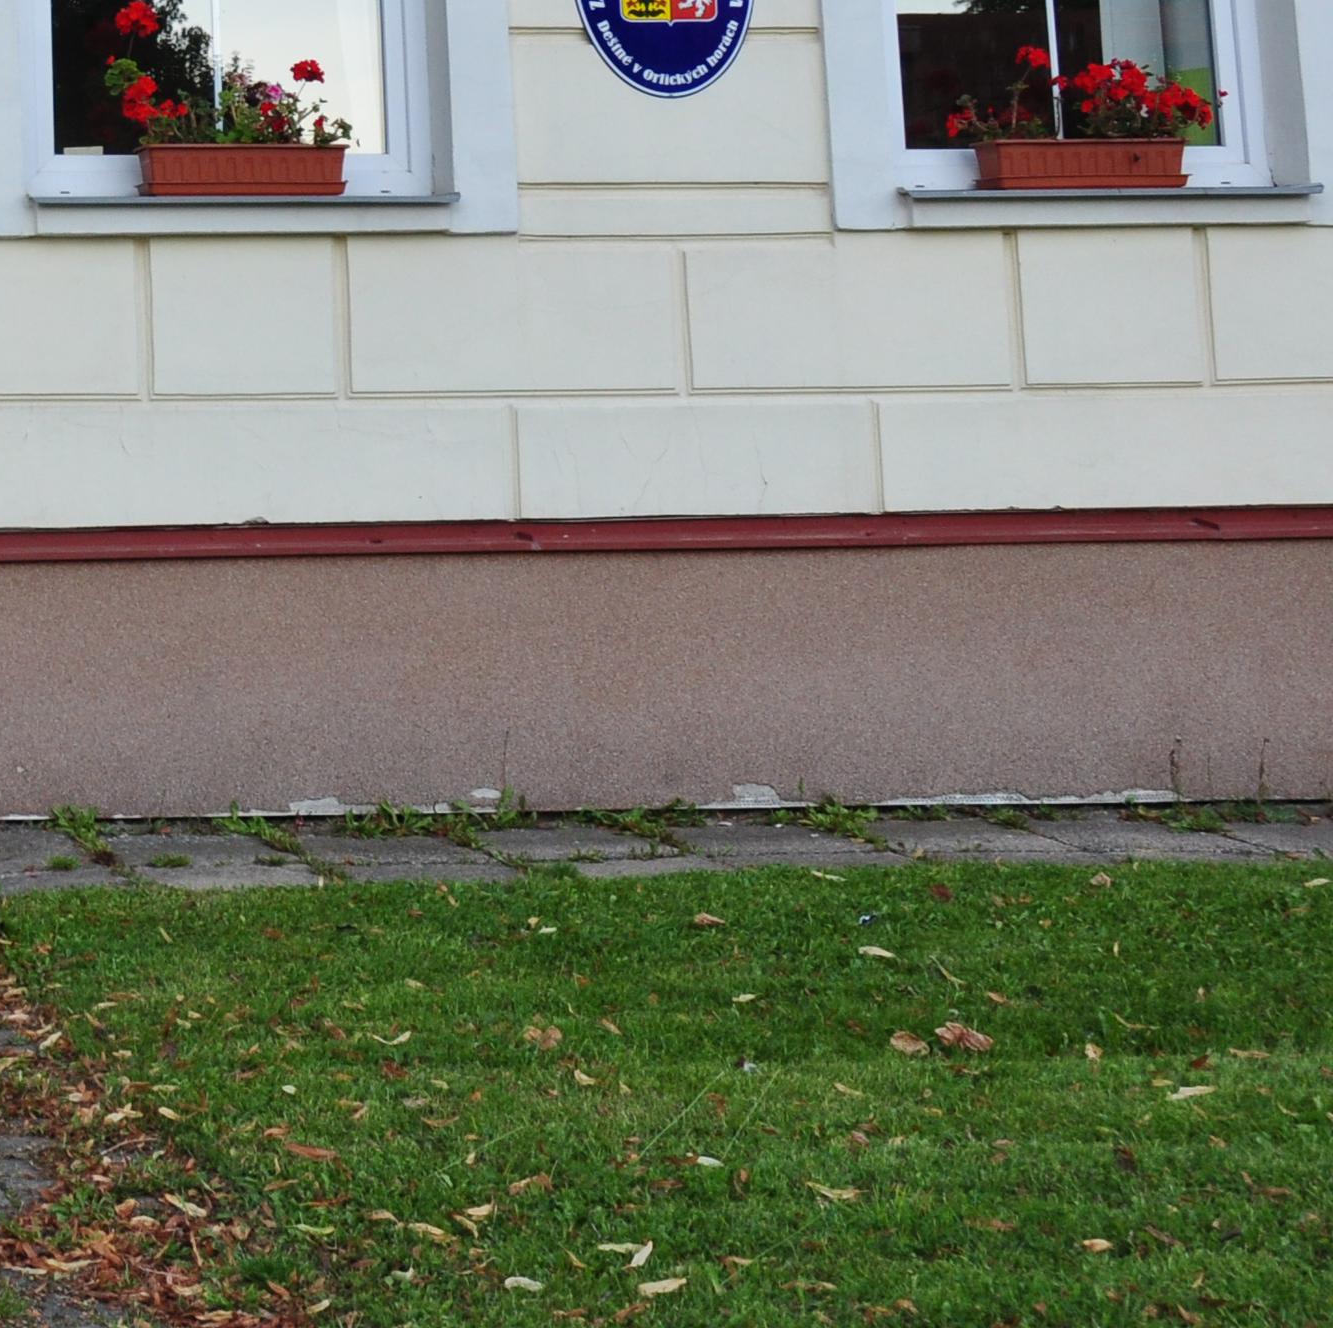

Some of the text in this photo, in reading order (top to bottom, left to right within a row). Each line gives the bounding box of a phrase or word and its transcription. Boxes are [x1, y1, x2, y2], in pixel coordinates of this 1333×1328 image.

[597, 19, 739, 85] Deštné v Orlických horách
